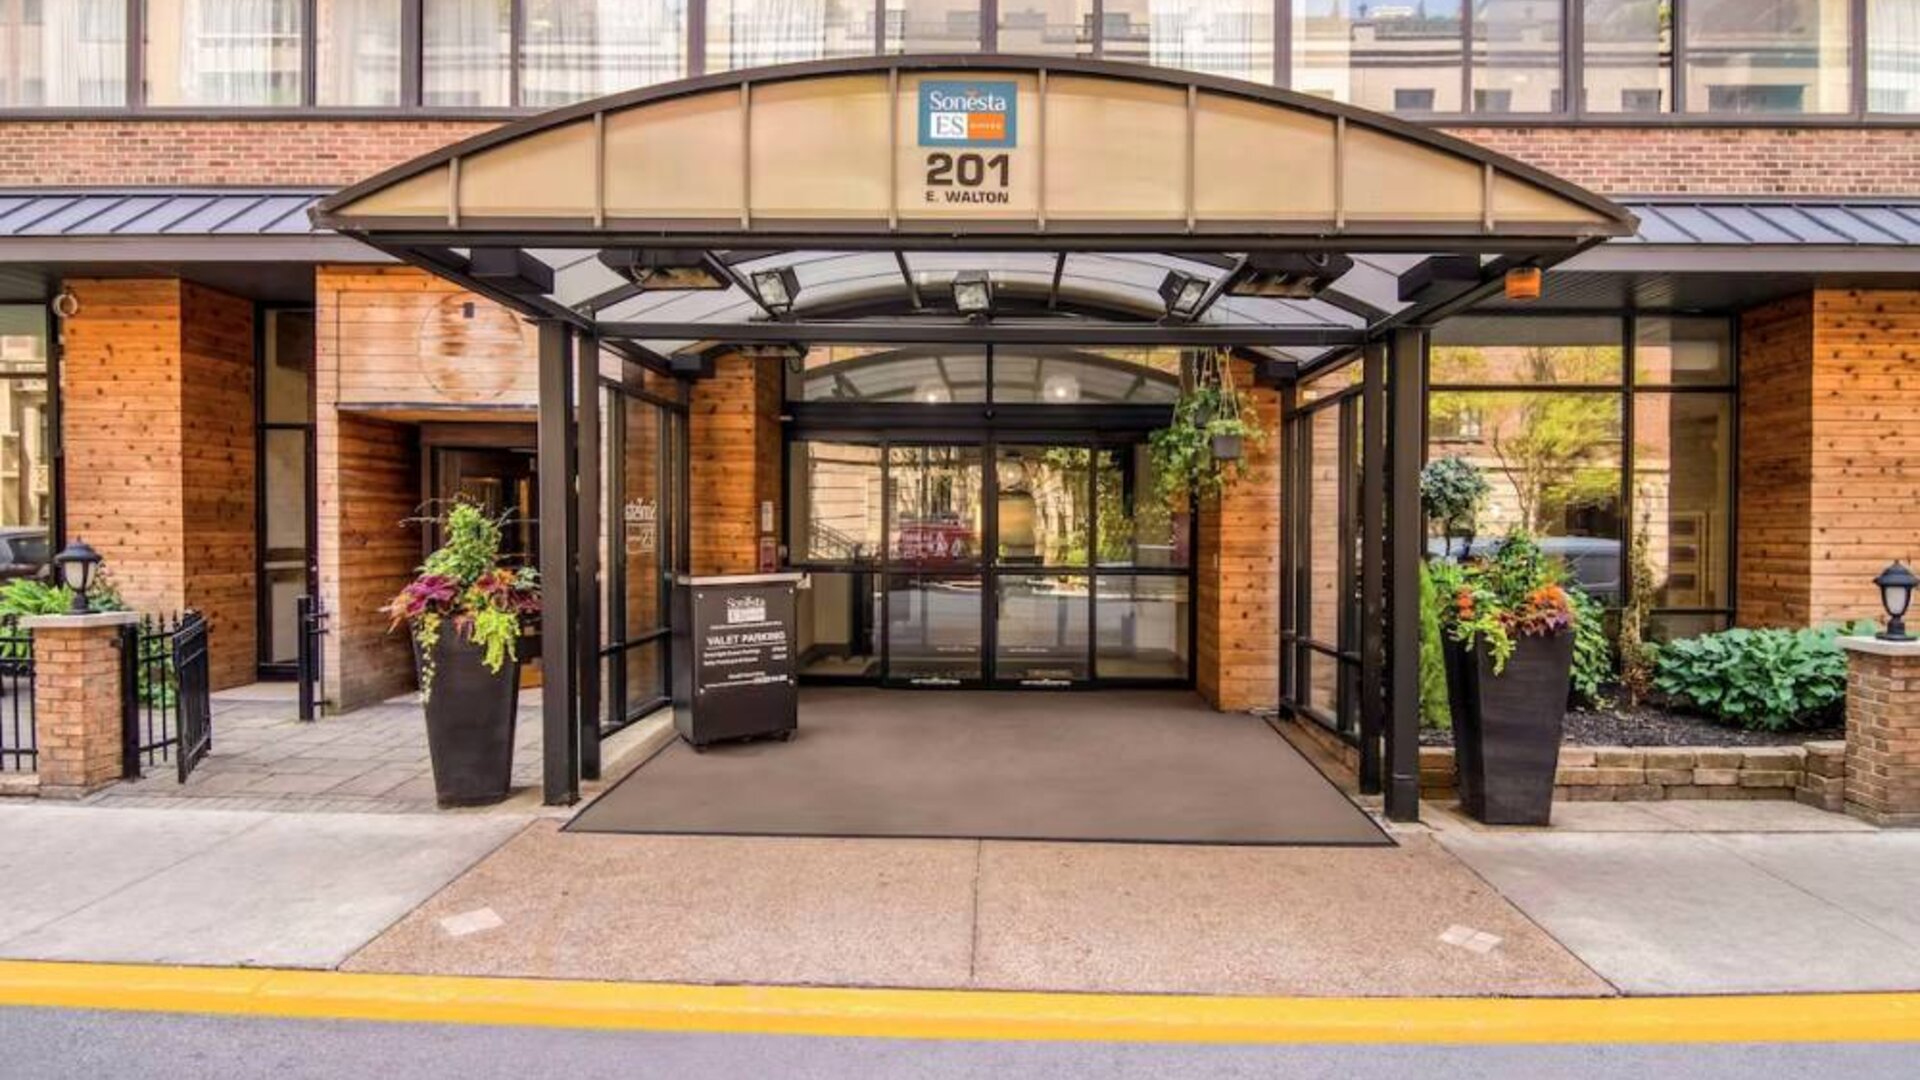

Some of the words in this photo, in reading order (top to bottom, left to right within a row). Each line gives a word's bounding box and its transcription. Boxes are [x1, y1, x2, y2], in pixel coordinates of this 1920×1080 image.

[930, 91, 1006, 111] Sonesta
[936, 116, 963, 135] ES
[926, 153, 1009, 187] 201
[946, 192, 1008, 204] WALTON
[706, 635, 739, 646] VALET
[742, 631, 786, 643] PARKING
